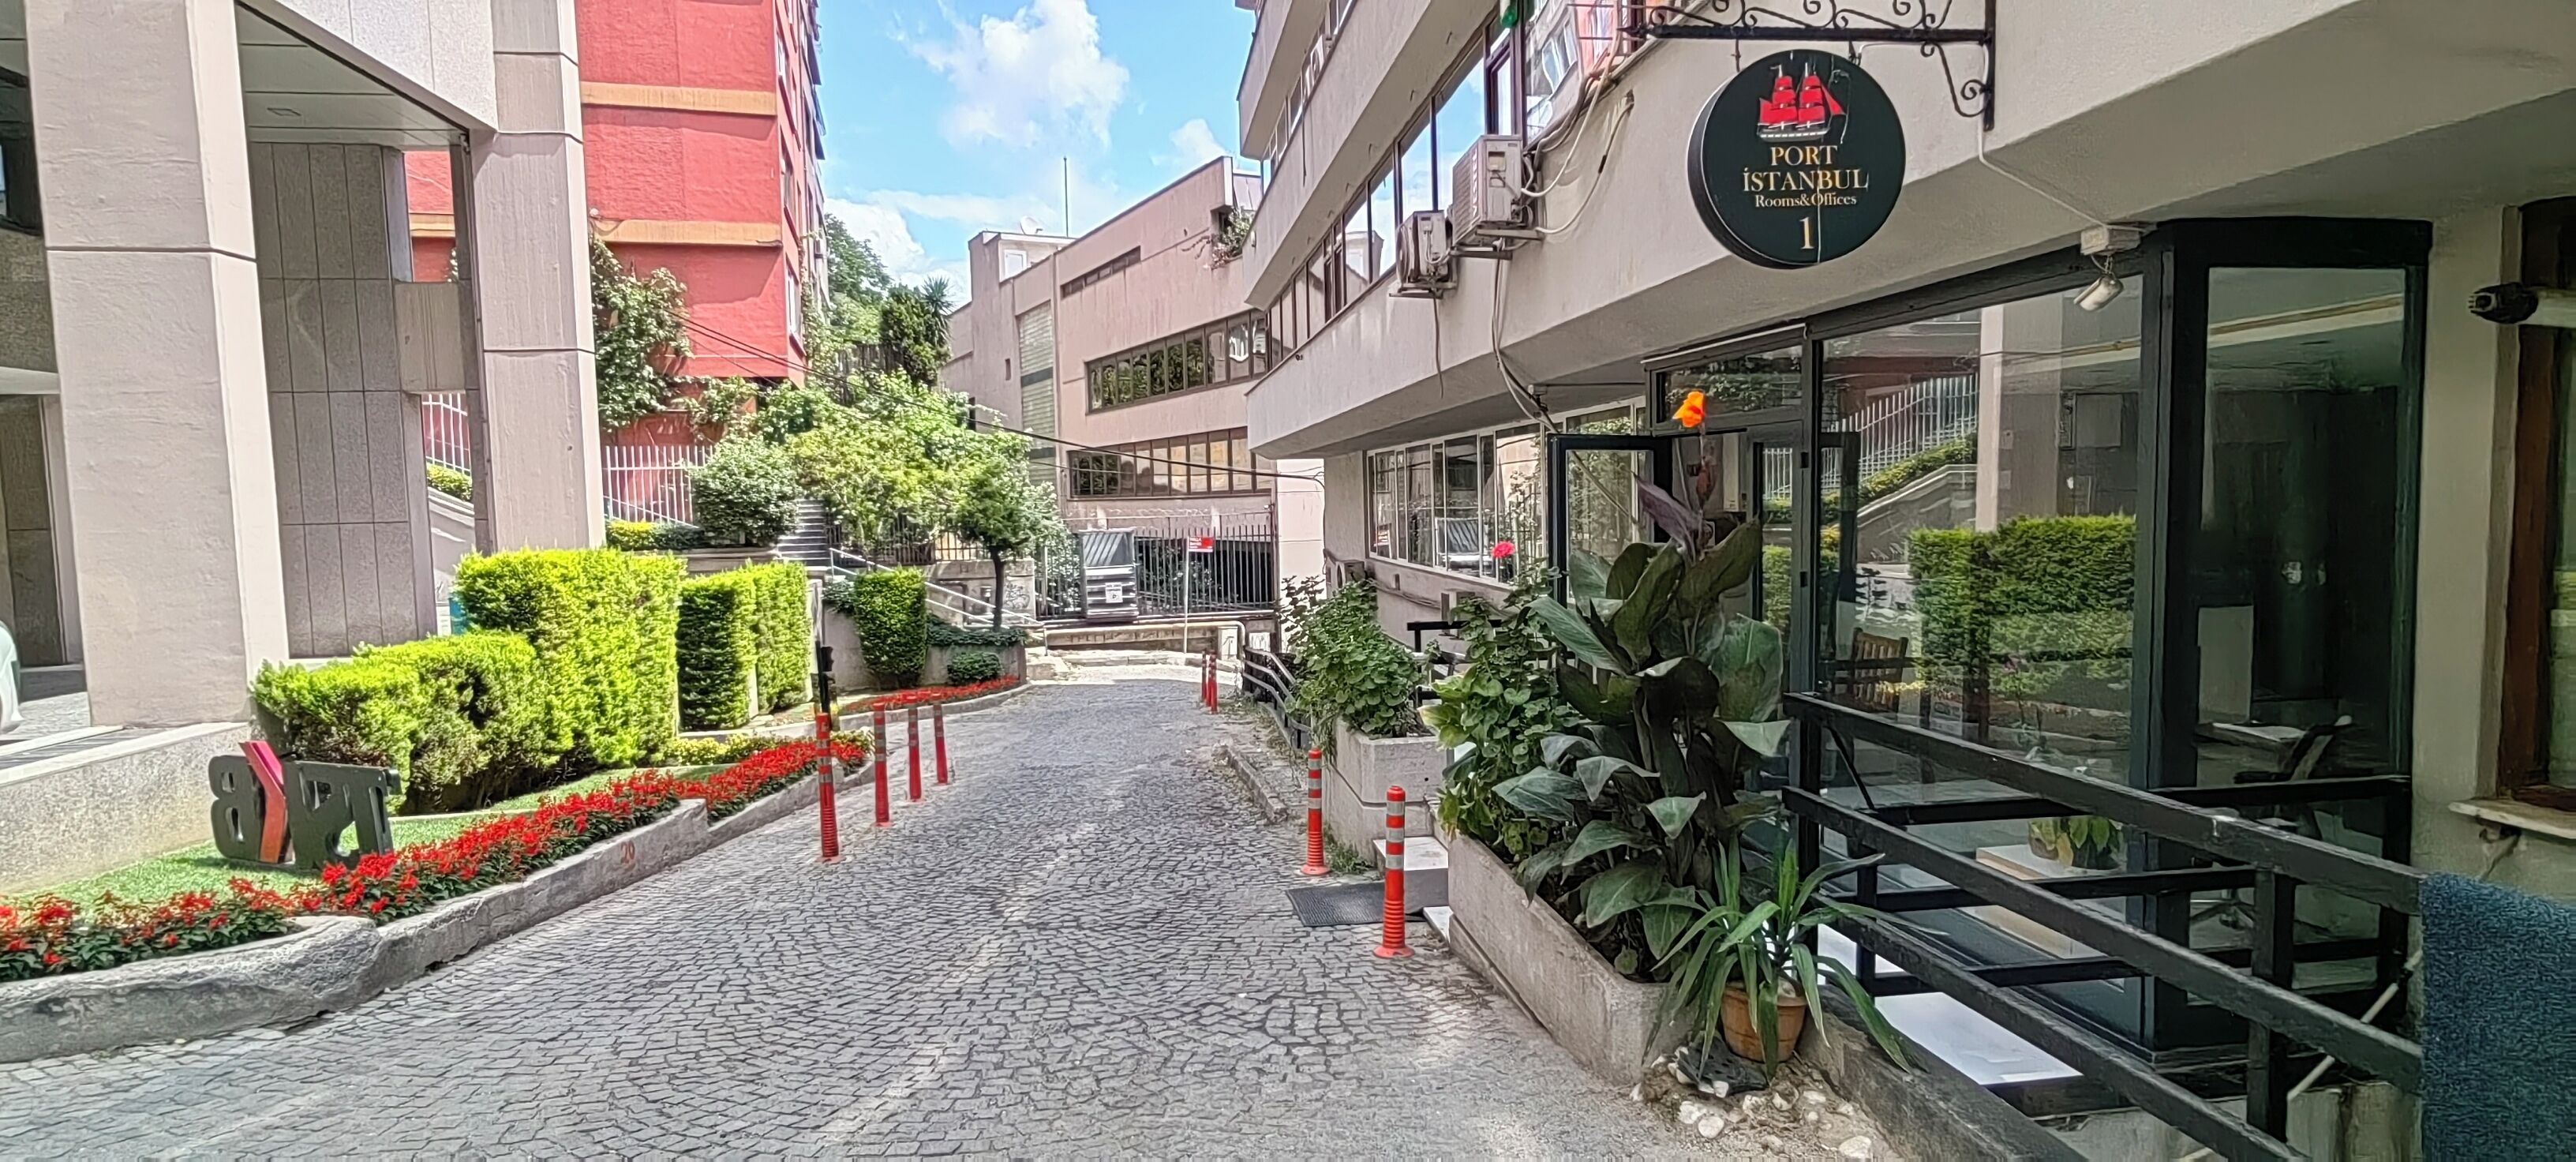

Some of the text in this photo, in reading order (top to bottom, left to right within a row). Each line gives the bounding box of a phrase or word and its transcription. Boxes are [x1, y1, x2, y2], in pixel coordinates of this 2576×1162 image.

[1769, 144, 1838, 166] PORT
[1742, 167, 1870, 192] İSTANBUL
[1754, 192, 1858, 208] Rooms&Offices
[1799, 216, 1815, 250] 1
